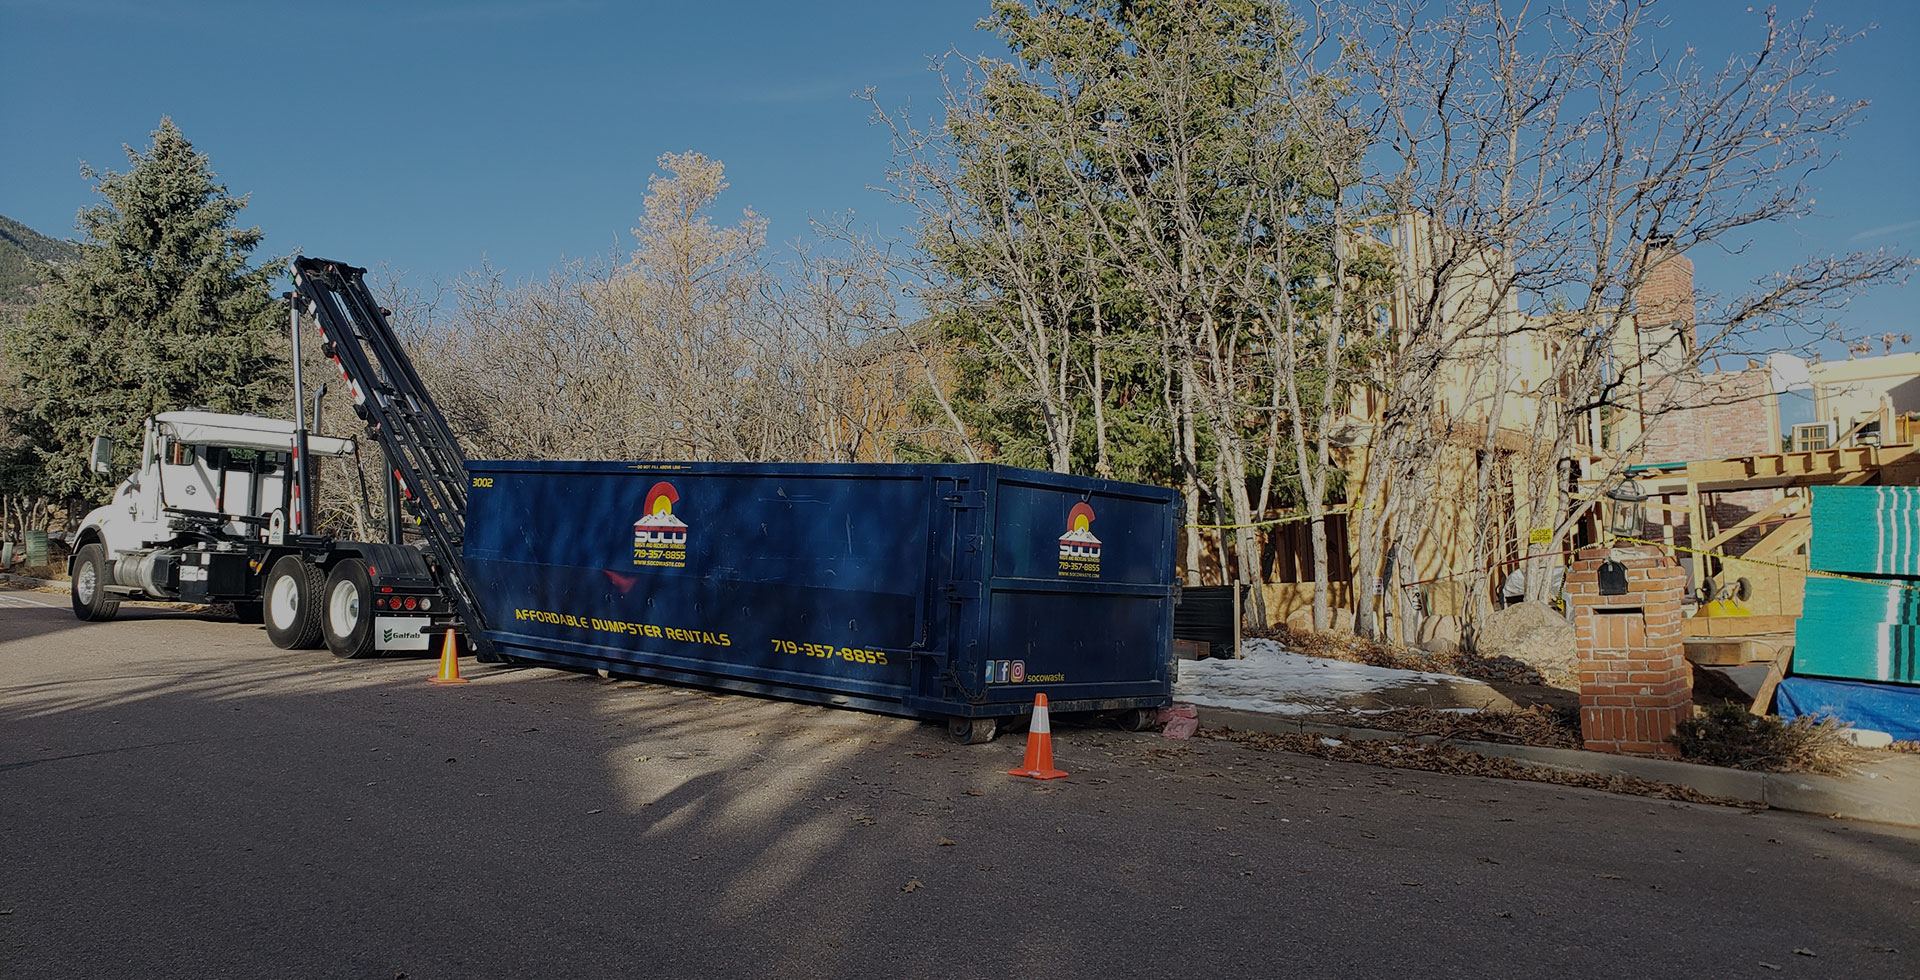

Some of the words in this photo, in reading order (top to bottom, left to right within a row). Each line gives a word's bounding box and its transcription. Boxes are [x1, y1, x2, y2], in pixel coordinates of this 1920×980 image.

[472, 477, 494, 488] 3002
[635, 526, 687, 544] SOCO
[634, 549, 686, 560] 719-357-8855
[1059, 541, 1101, 557] SOCO
[515, 608, 590, 629] AFFORDABLE
[591, 618, 663, 639] DUMPSTER
[664, 626, 732, 647] RENTALS
[770, 639, 889, 666] 719-357-8855
